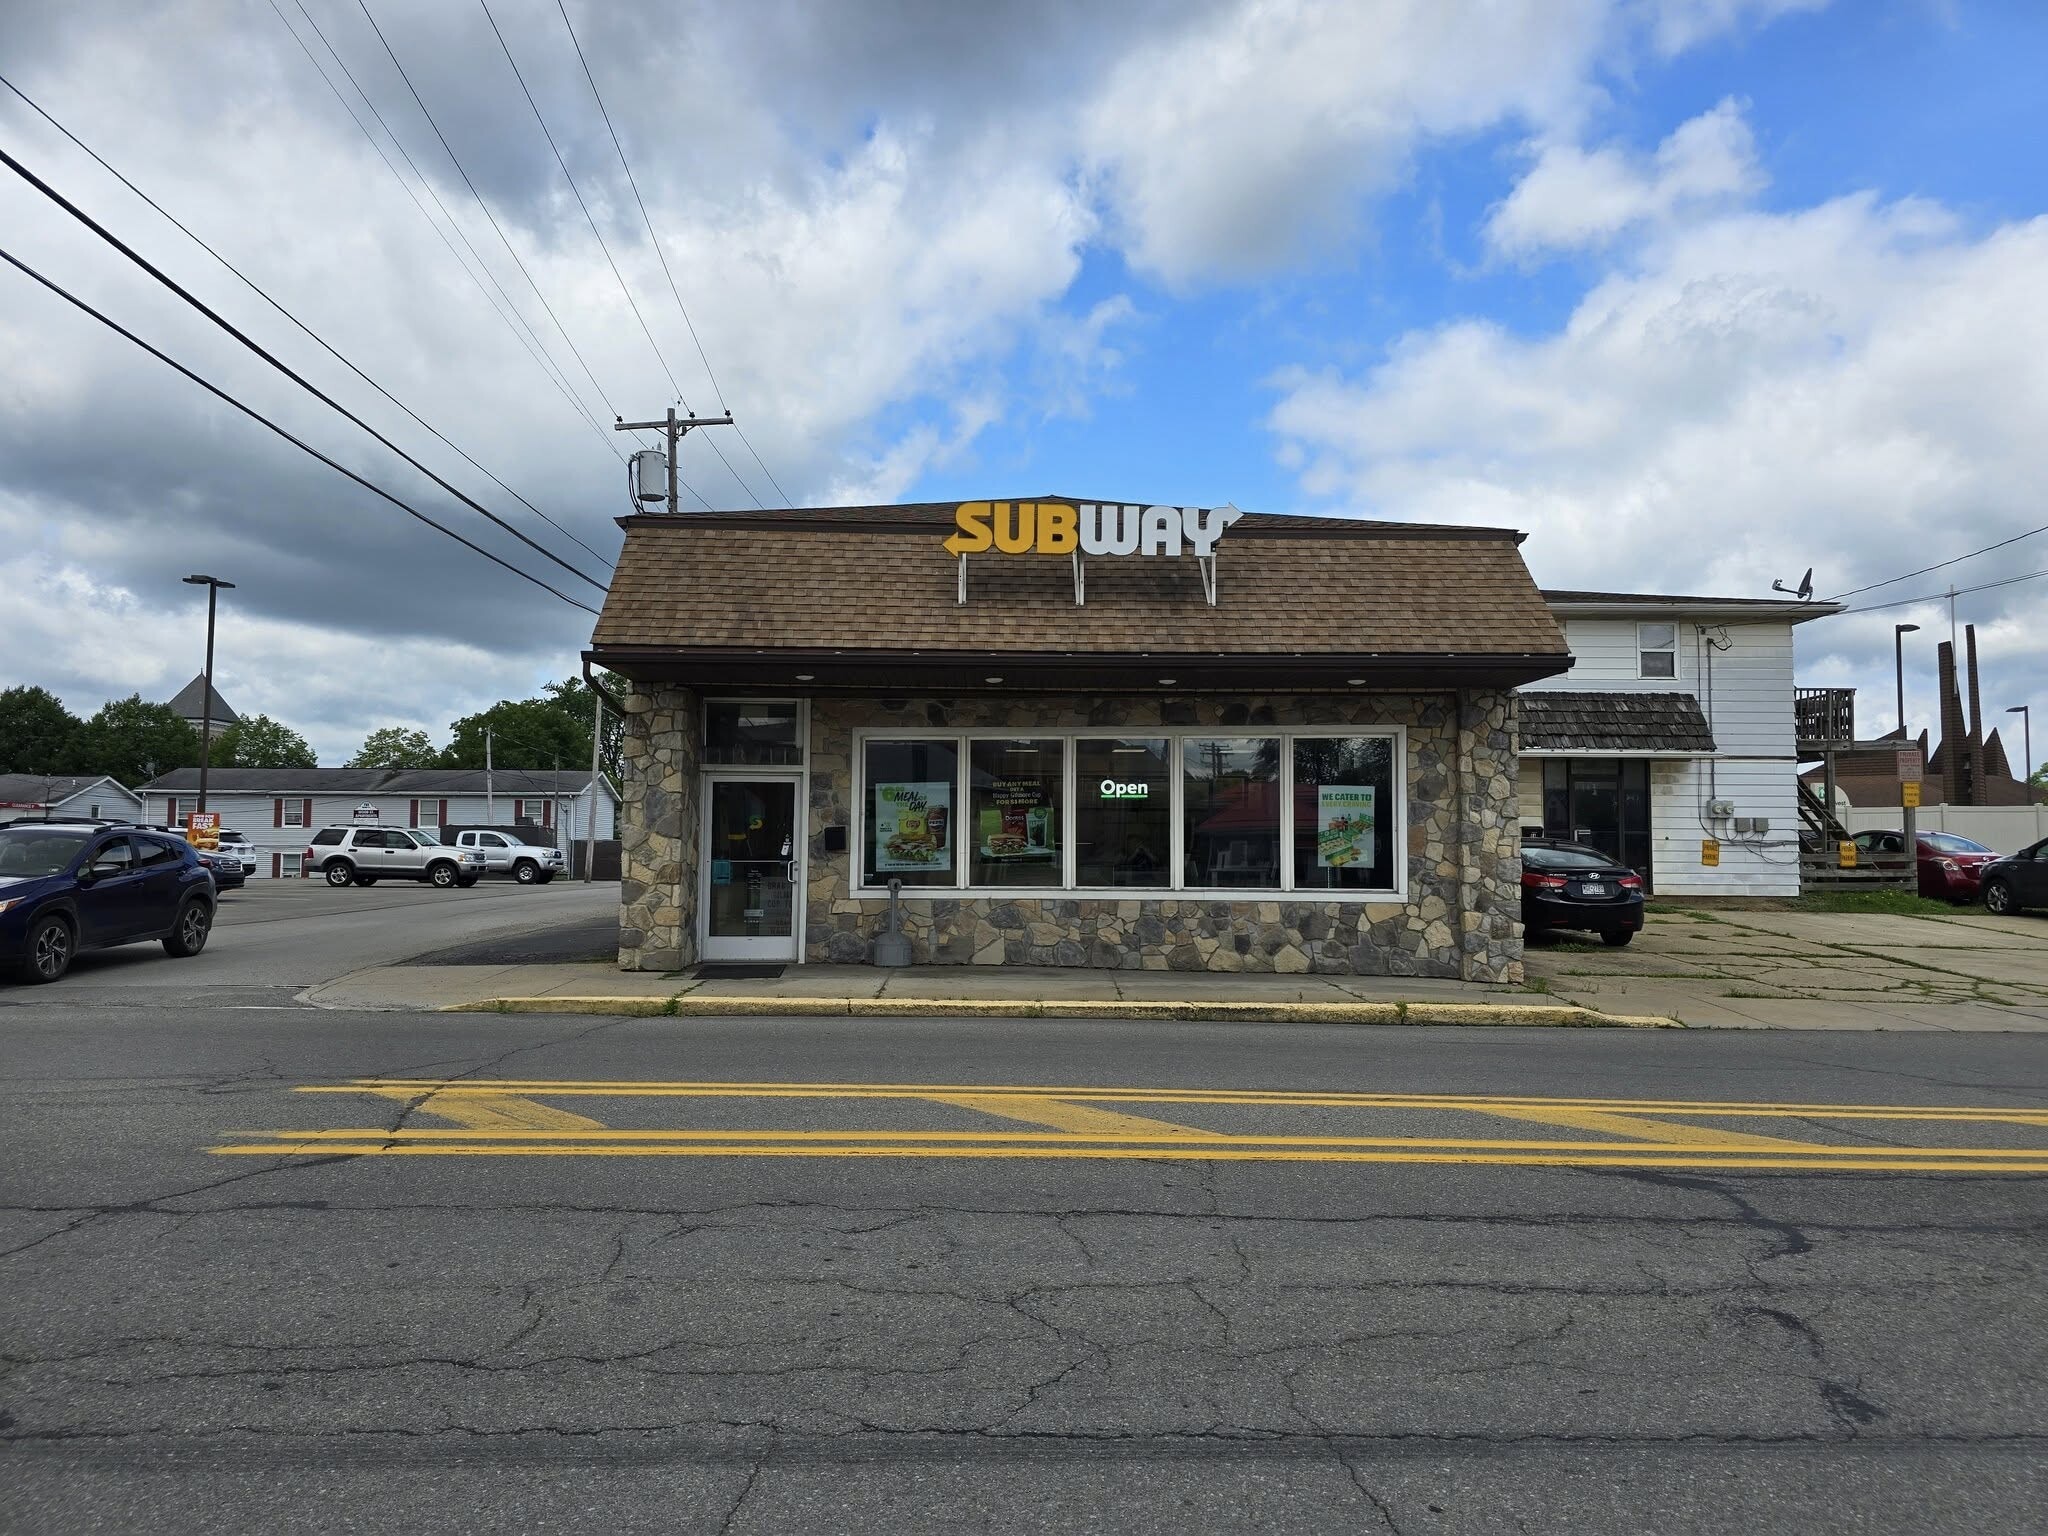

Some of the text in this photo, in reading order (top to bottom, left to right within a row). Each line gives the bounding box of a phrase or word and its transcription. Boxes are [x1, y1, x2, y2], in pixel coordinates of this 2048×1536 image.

[943, 502, 1244, 557] SUBWAY
[1101, 780, 1148, 797] Open
[894, 791, 919, 802] MEAL
[909, 801, 927, 812] DAY
